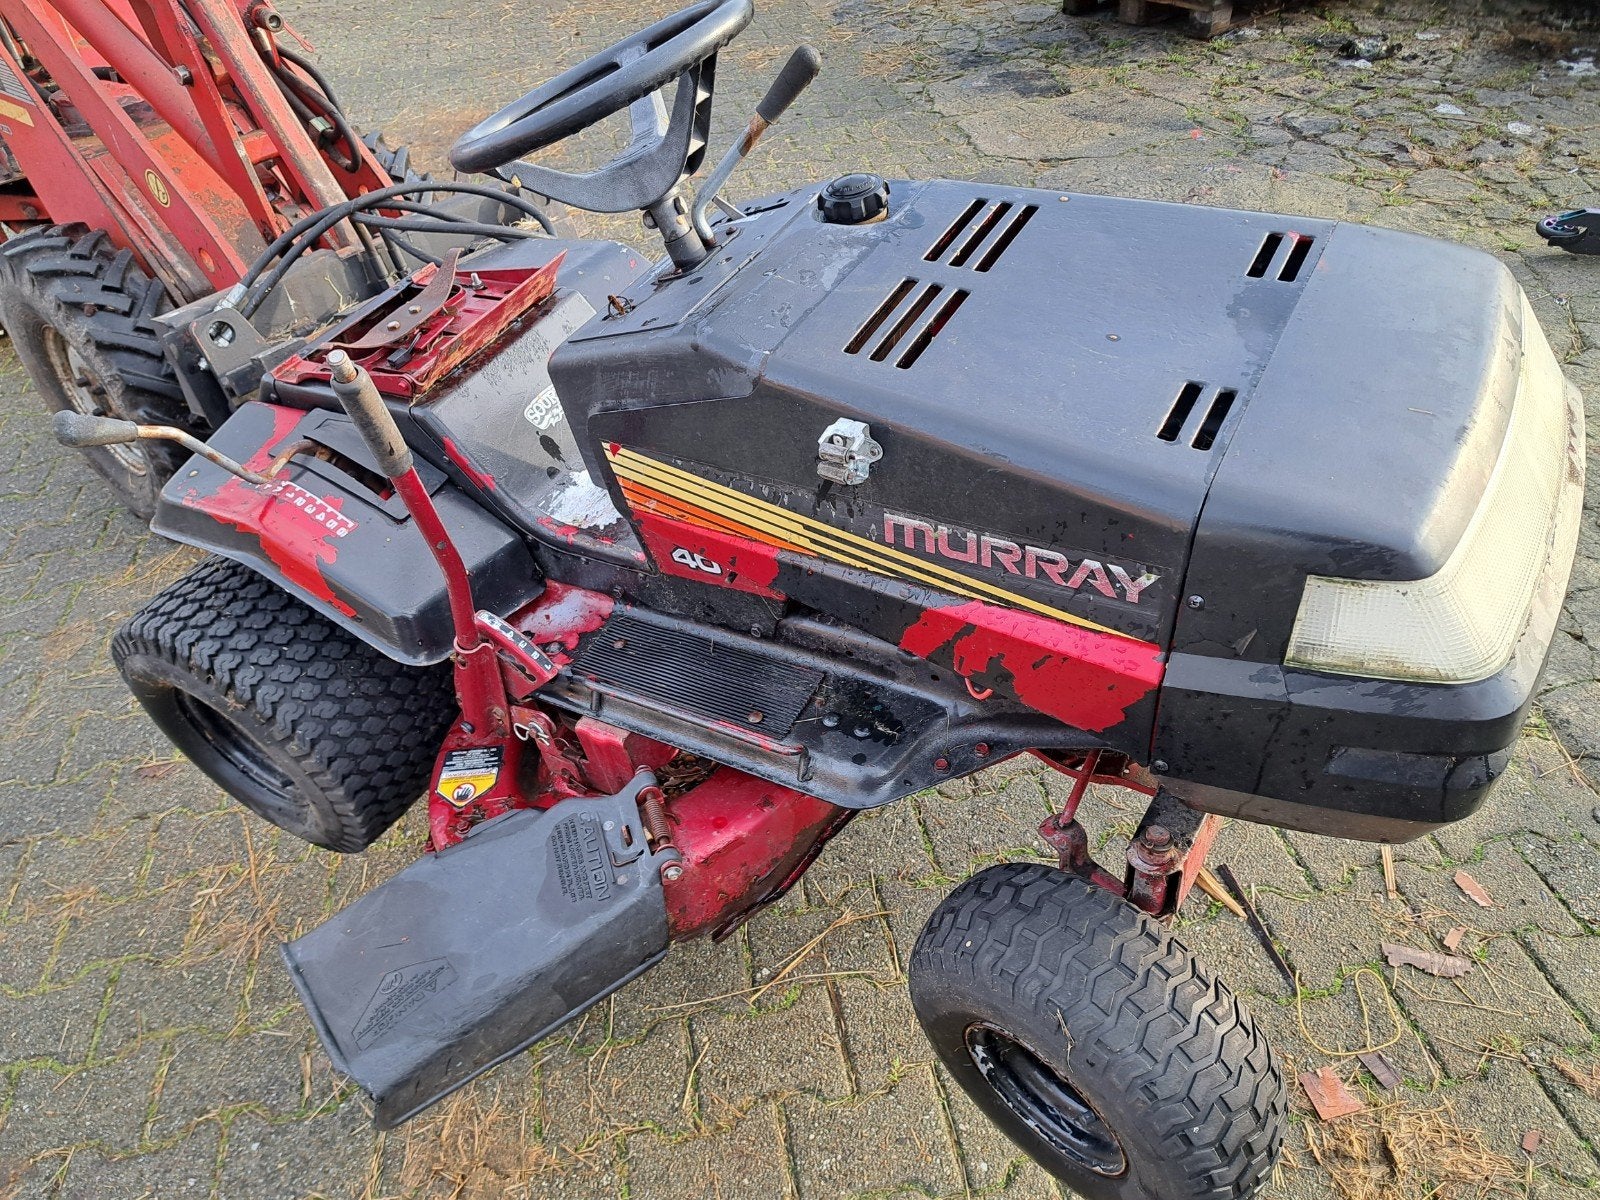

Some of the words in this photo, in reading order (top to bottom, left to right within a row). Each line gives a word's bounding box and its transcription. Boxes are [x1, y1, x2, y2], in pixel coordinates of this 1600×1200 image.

[315, 511, 326, 521] 4
[325, 519, 339, 530] 5
[671, 548, 722, 574] 40
[883, 513, 1161, 604] MURRAY
[578, 811, 610, 902] CAUTION
